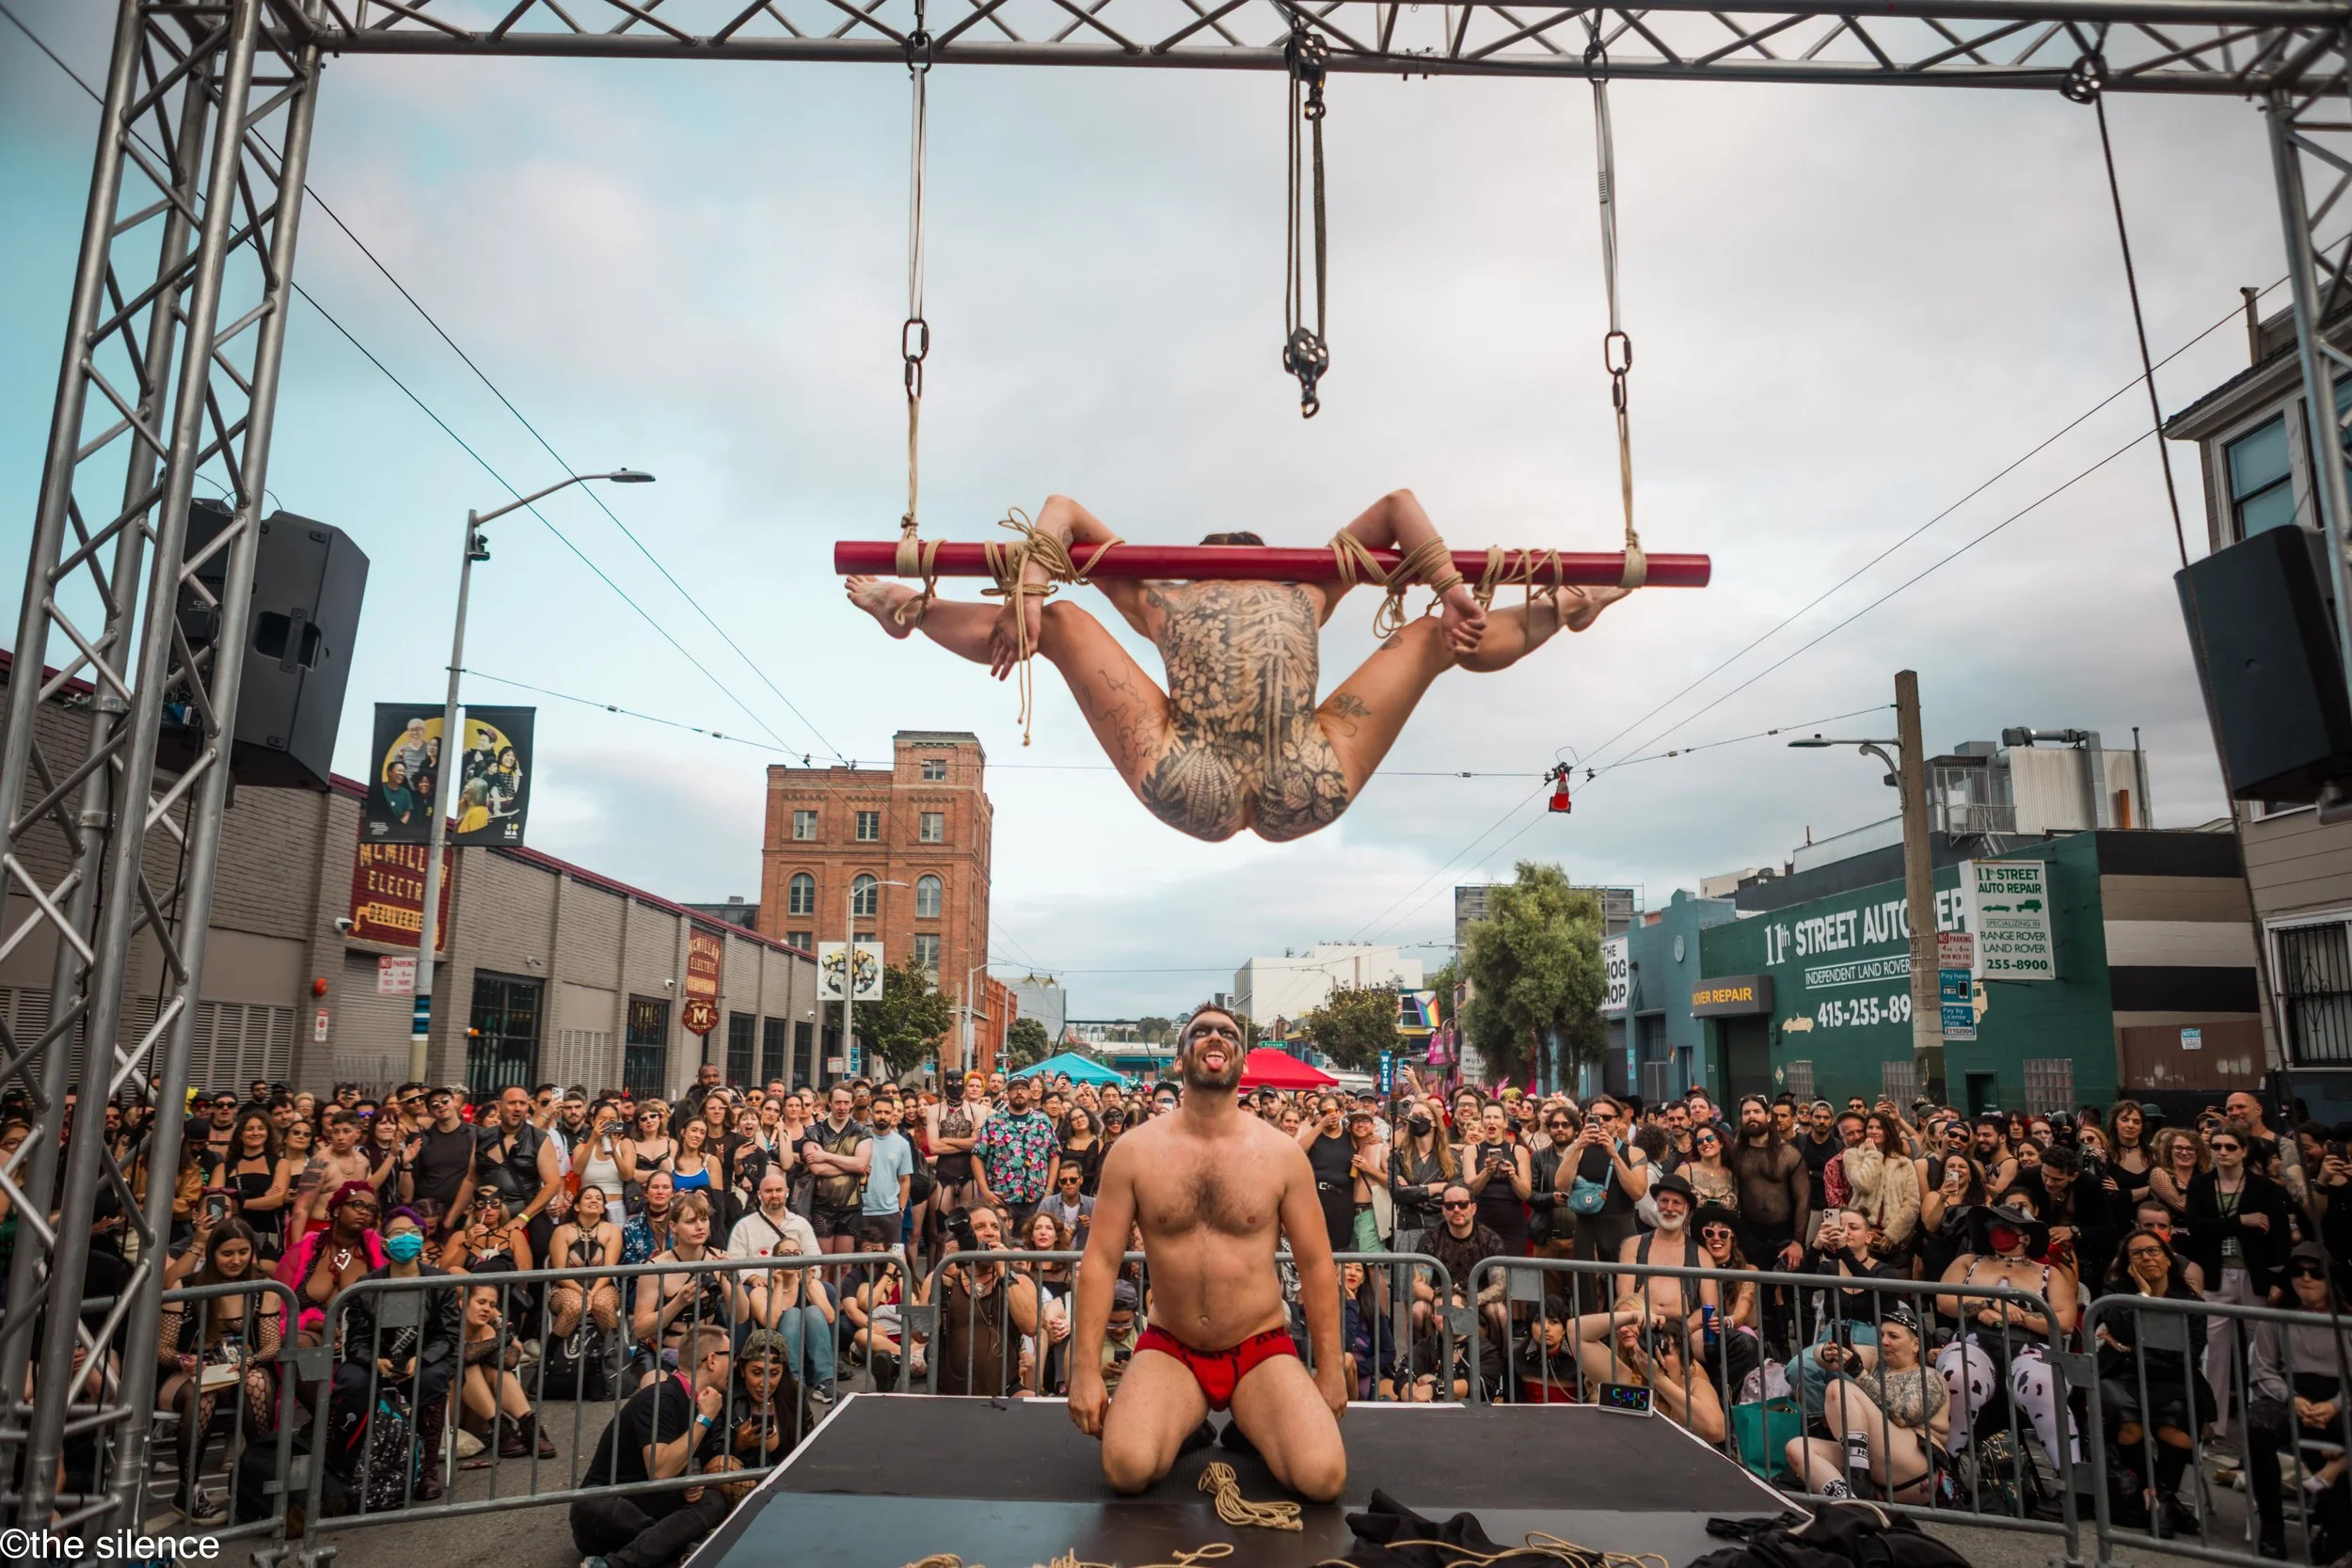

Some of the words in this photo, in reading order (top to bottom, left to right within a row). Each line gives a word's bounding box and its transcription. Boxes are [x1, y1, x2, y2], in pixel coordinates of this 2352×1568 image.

[1996, 869, 2039, 880] STREET
[368, 870, 422, 901] ELECTR
[1979, 883, 2004, 894] AUTO
[2007, 884, 2042, 894] REPAIR
[370, 904, 423, 930] DELIVERIE
[1764, 922, 1790, 966] 11th
[1795, 910, 1857, 957] STREET
[1863, 897, 1910, 945] AUTO
[1939, 933, 1948, 943] NO
[1980, 931, 2014, 941] RANGE
[2016, 932, 2046, 941] ROVER
[1603, 944, 1616, 958] THE
[1983, 943, 2011, 953] LAND
[2014, 944, 2046, 953] ROVER
[691, 957, 716, 974] ELECTRIC
[1804, 968, 1855, 986] INDEPENDENT
[1858, 963, 1882, 979] LAND
[1883, 958, 1911, 975] ROVER
[1986, 959, 2048, 970] 255-8900
[1712, 988, 1753, 1003] REPAIR
[693, 1008, 707, 1023] M
[1818, 993, 1912, 1028] 415-255-89
[1943, 1006, 1954, 1015] Pay
[1381, 1055, 1390, 1092] WATER
[1613, 1387, 1646, 1409] 5:45
